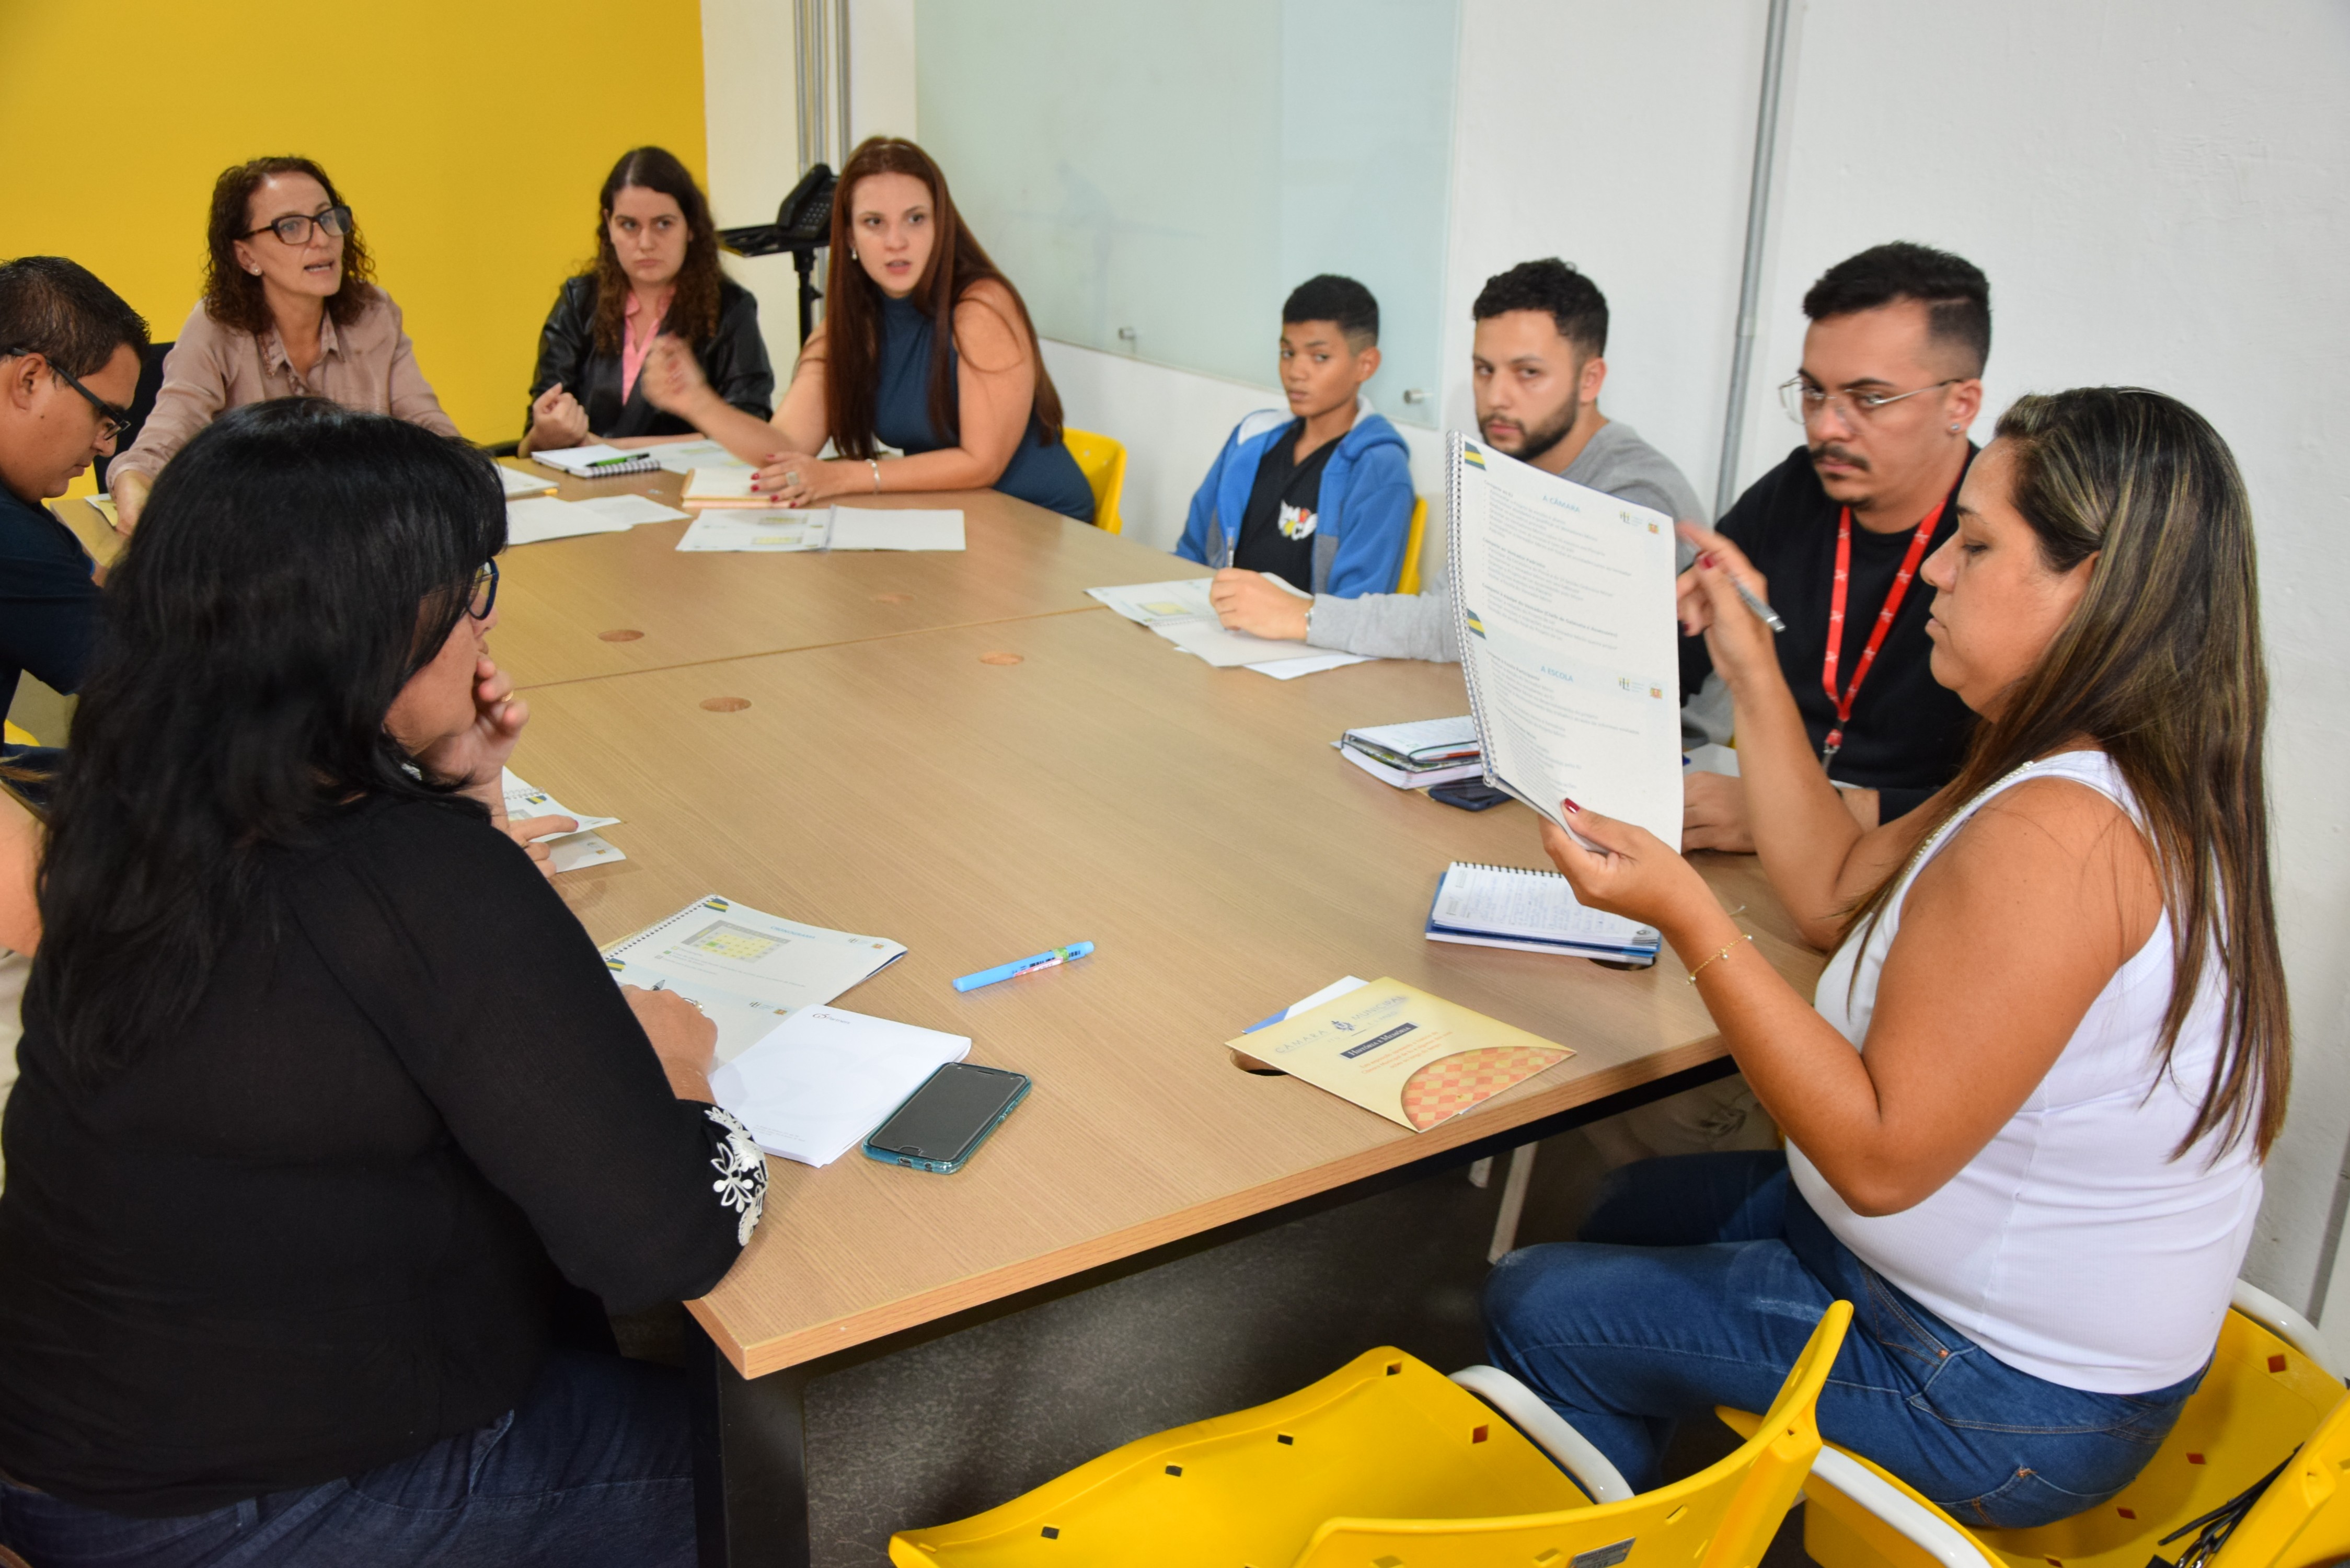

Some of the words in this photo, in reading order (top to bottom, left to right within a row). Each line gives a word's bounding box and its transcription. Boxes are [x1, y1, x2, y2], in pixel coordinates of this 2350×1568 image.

[1550, 497, 1581, 513] CÂMARA
[1548, 667, 1573, 683] ESCOLA
[1275, 1030, 1328, 1054] CÂMARA
[1351, 996, 1407, 1021] MUNICIPAL
